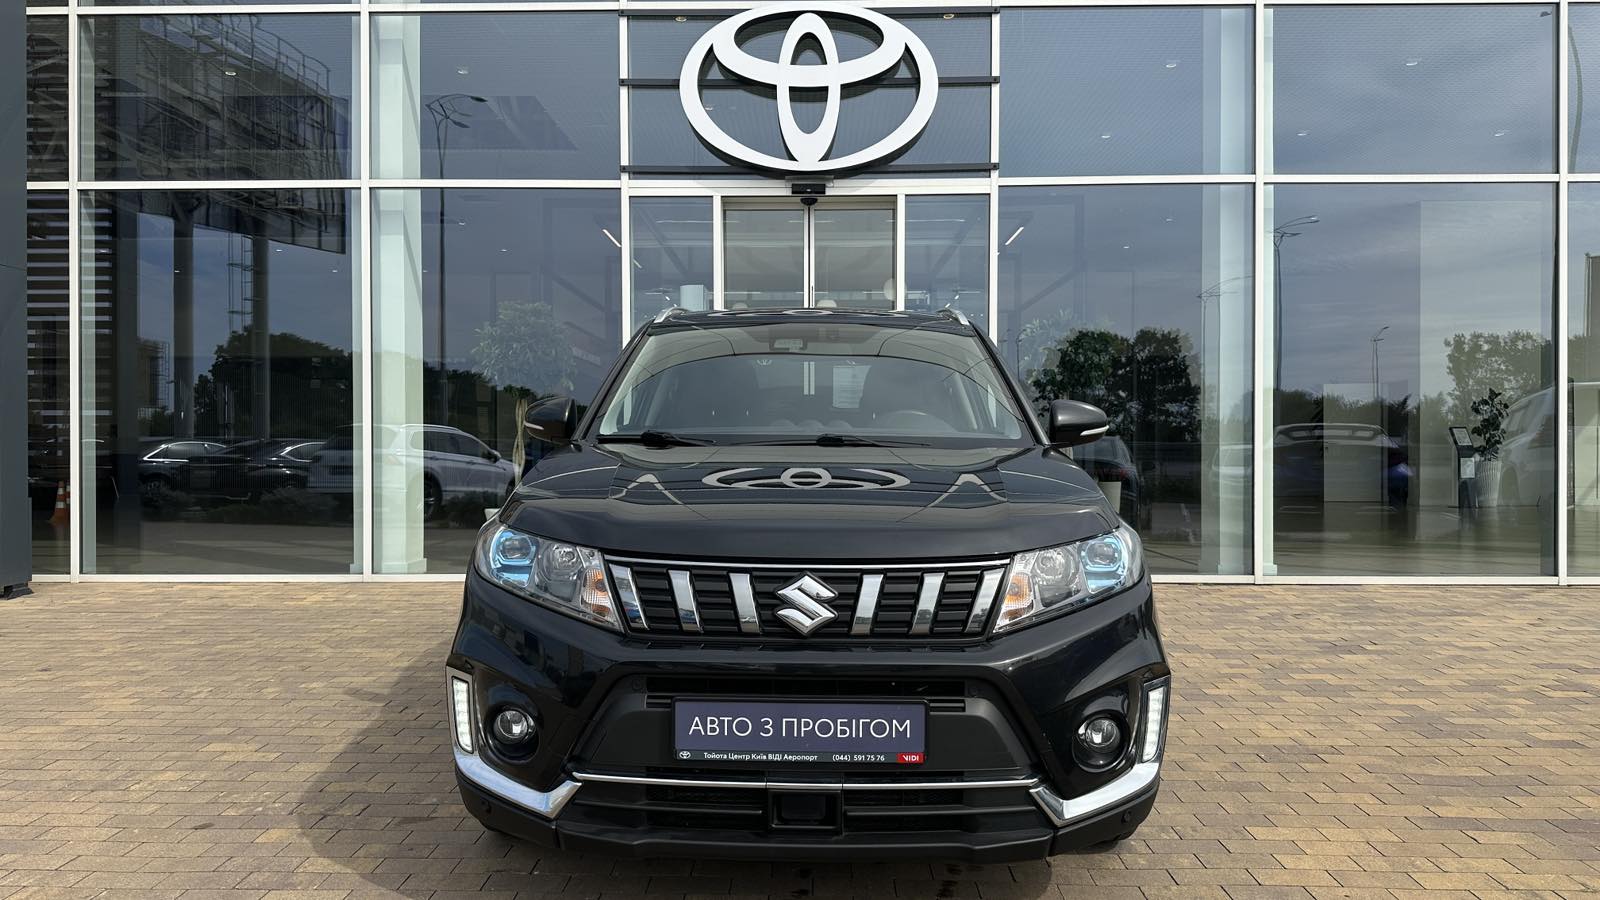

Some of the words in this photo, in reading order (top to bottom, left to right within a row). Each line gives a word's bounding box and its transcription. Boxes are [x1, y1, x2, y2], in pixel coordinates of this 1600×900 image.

[688, 716, 753, 737] АВТО
[782, 718, 911, 739] ПРОБІГОМ
[703, 752, 727, 760] Тойота
[728, 752, 750, 761] Центр
[768, 753, 782, 761] ВІДІ
[783, 753, 818, 762] Аеропорт
[832, 754, 851, 762] (044)
